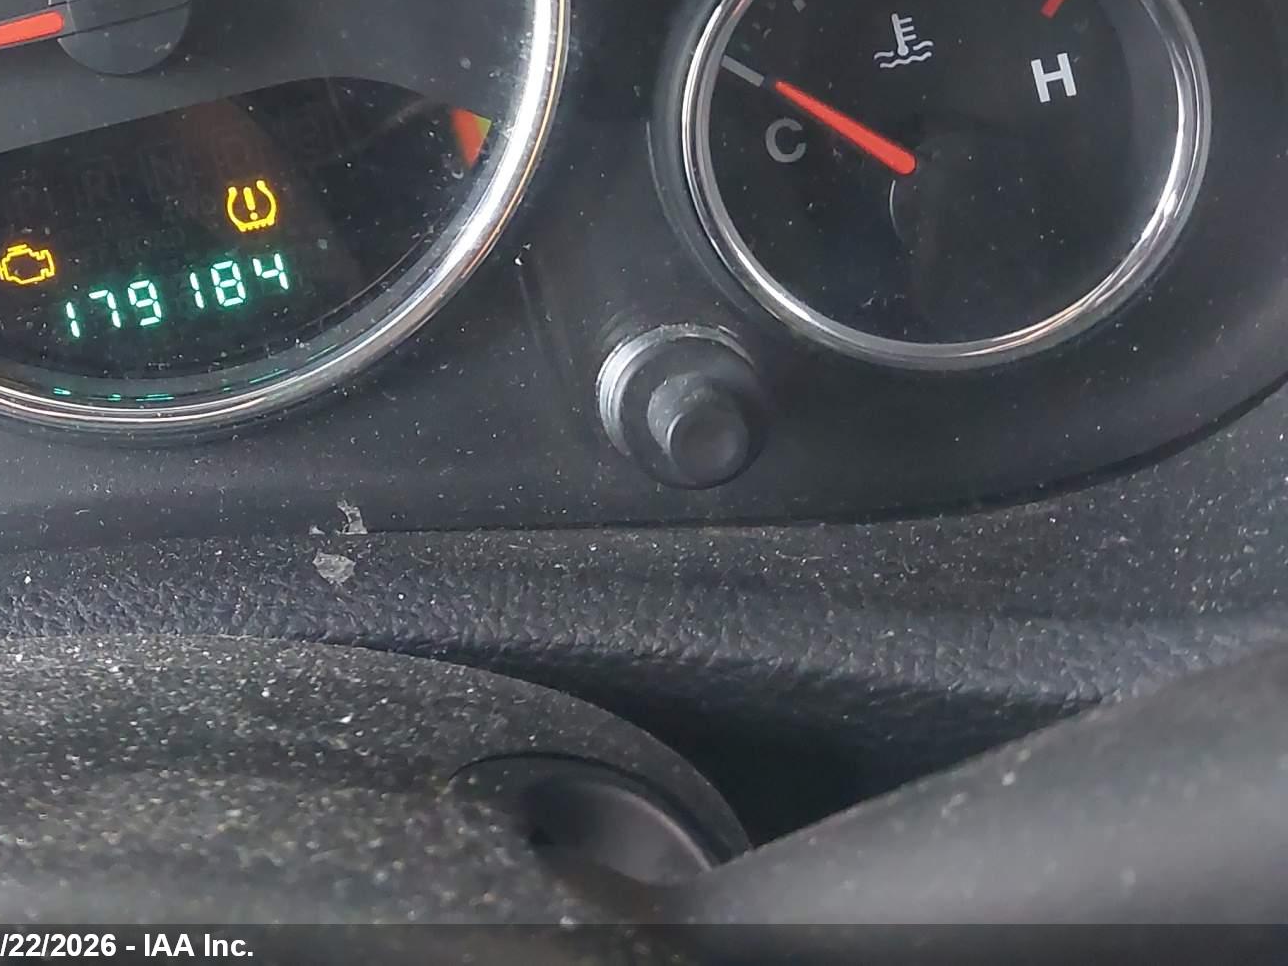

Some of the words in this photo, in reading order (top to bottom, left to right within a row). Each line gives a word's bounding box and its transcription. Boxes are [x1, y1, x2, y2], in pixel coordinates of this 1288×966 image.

[1031, 52, 1077, 103] H
[765, 118, 806, 163] C
[65, 252, 290, 338] 179184
